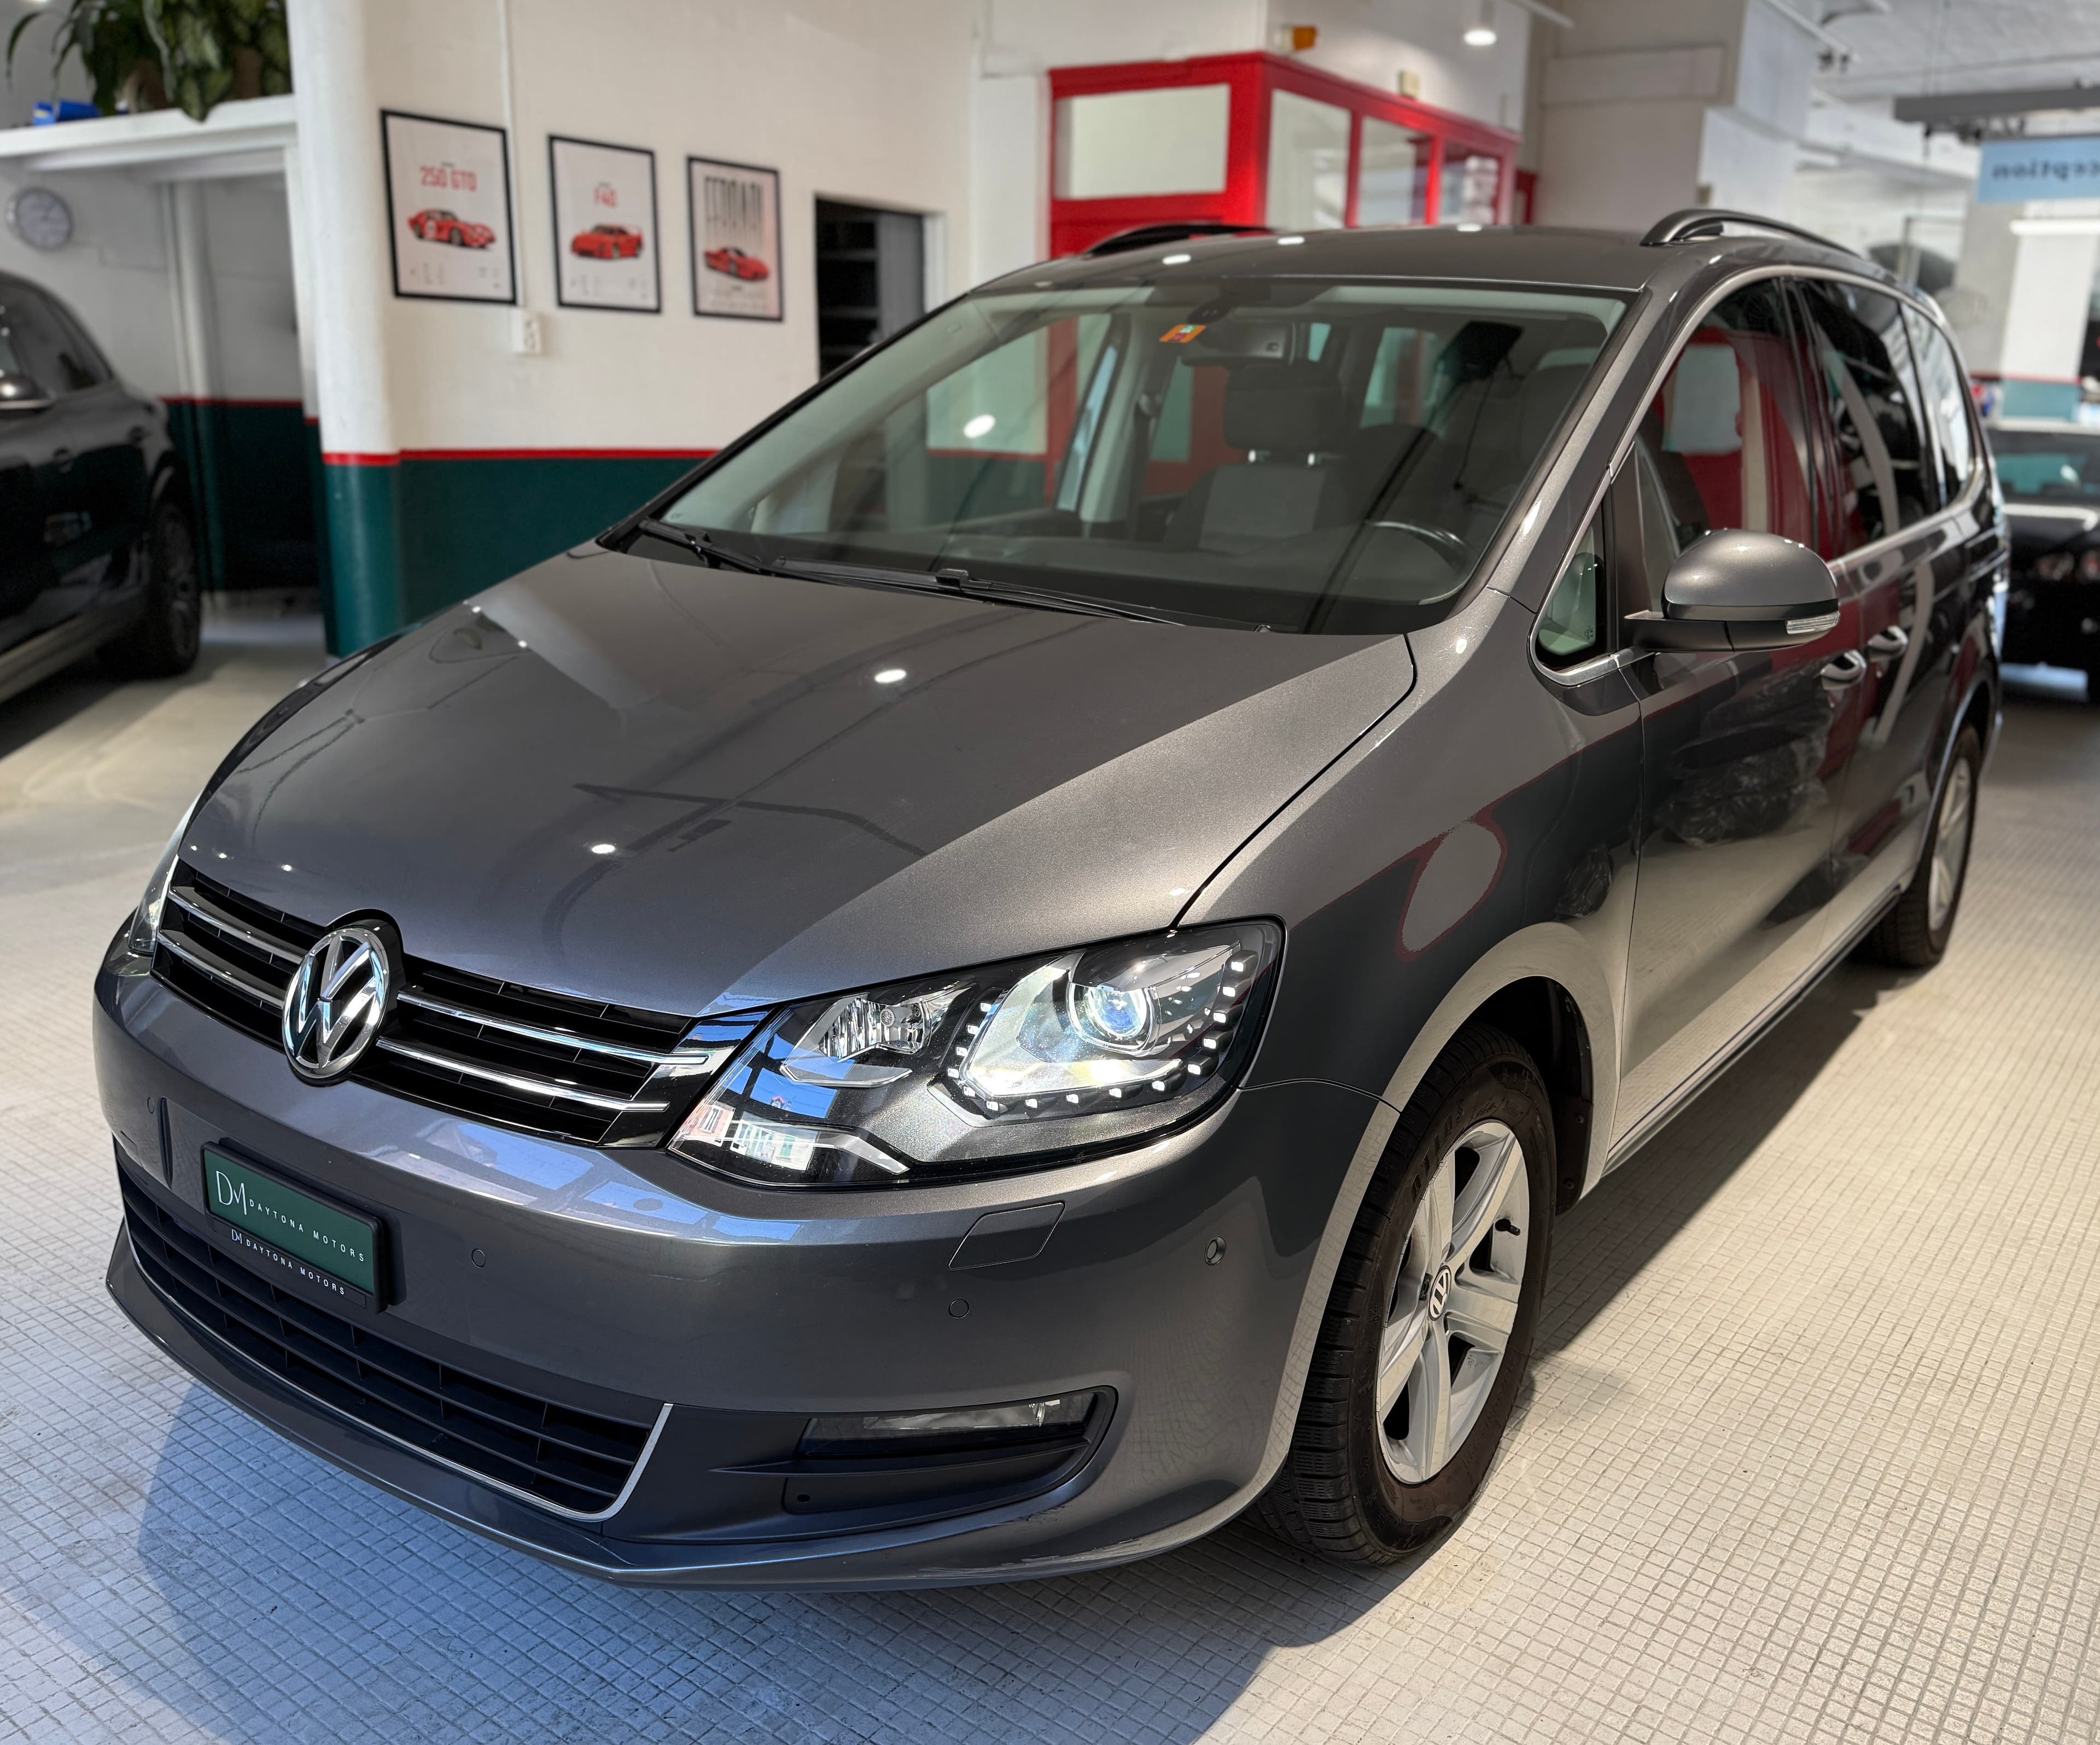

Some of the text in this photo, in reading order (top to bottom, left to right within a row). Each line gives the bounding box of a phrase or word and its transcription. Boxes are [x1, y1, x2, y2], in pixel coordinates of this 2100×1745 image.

[419, 165, 477, 192] 250 GTO
[249, 1199, 304, 1232] DAYTONA
[313, 1230, 364, 1262] MOTORS
[246, 1239, 293, 1269] DAYTONA
[300, 1267, 345, 1295] MOTORS
